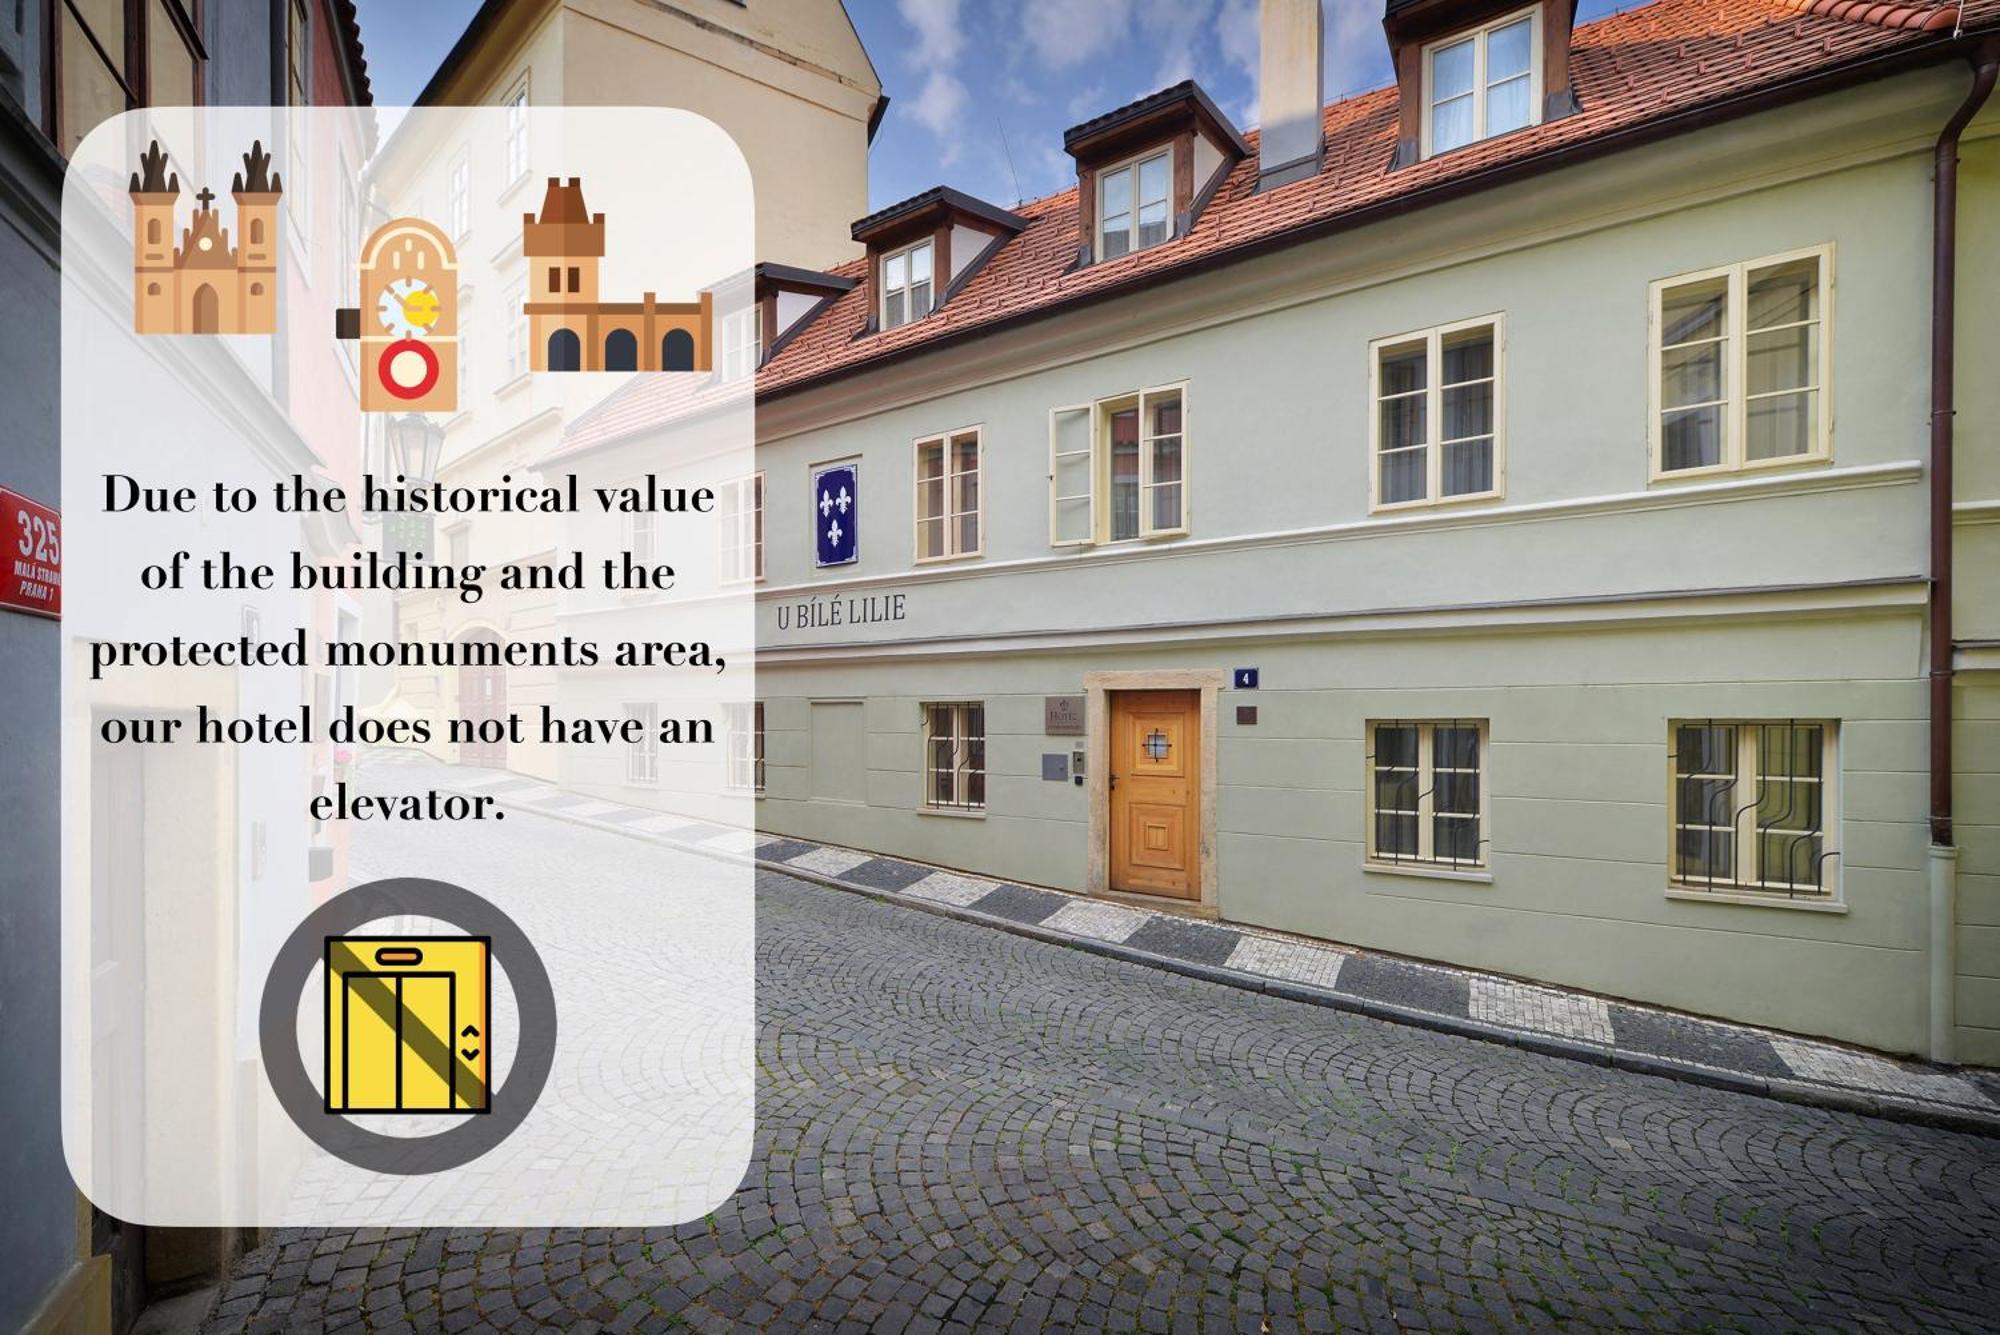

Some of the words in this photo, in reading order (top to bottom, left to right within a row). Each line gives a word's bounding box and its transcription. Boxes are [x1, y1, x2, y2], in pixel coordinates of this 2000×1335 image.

[17, 509, 60, 565] 325
[19, 580, 48, 601] PRAHA
[49, 587, 54, 602] 1
[777, 606, 790, 631] U
[797, 593, 842, 629] BÍLÉ
[849, 594, 906, 624] LILIE
[1242, 672, 1249, 685] 4
